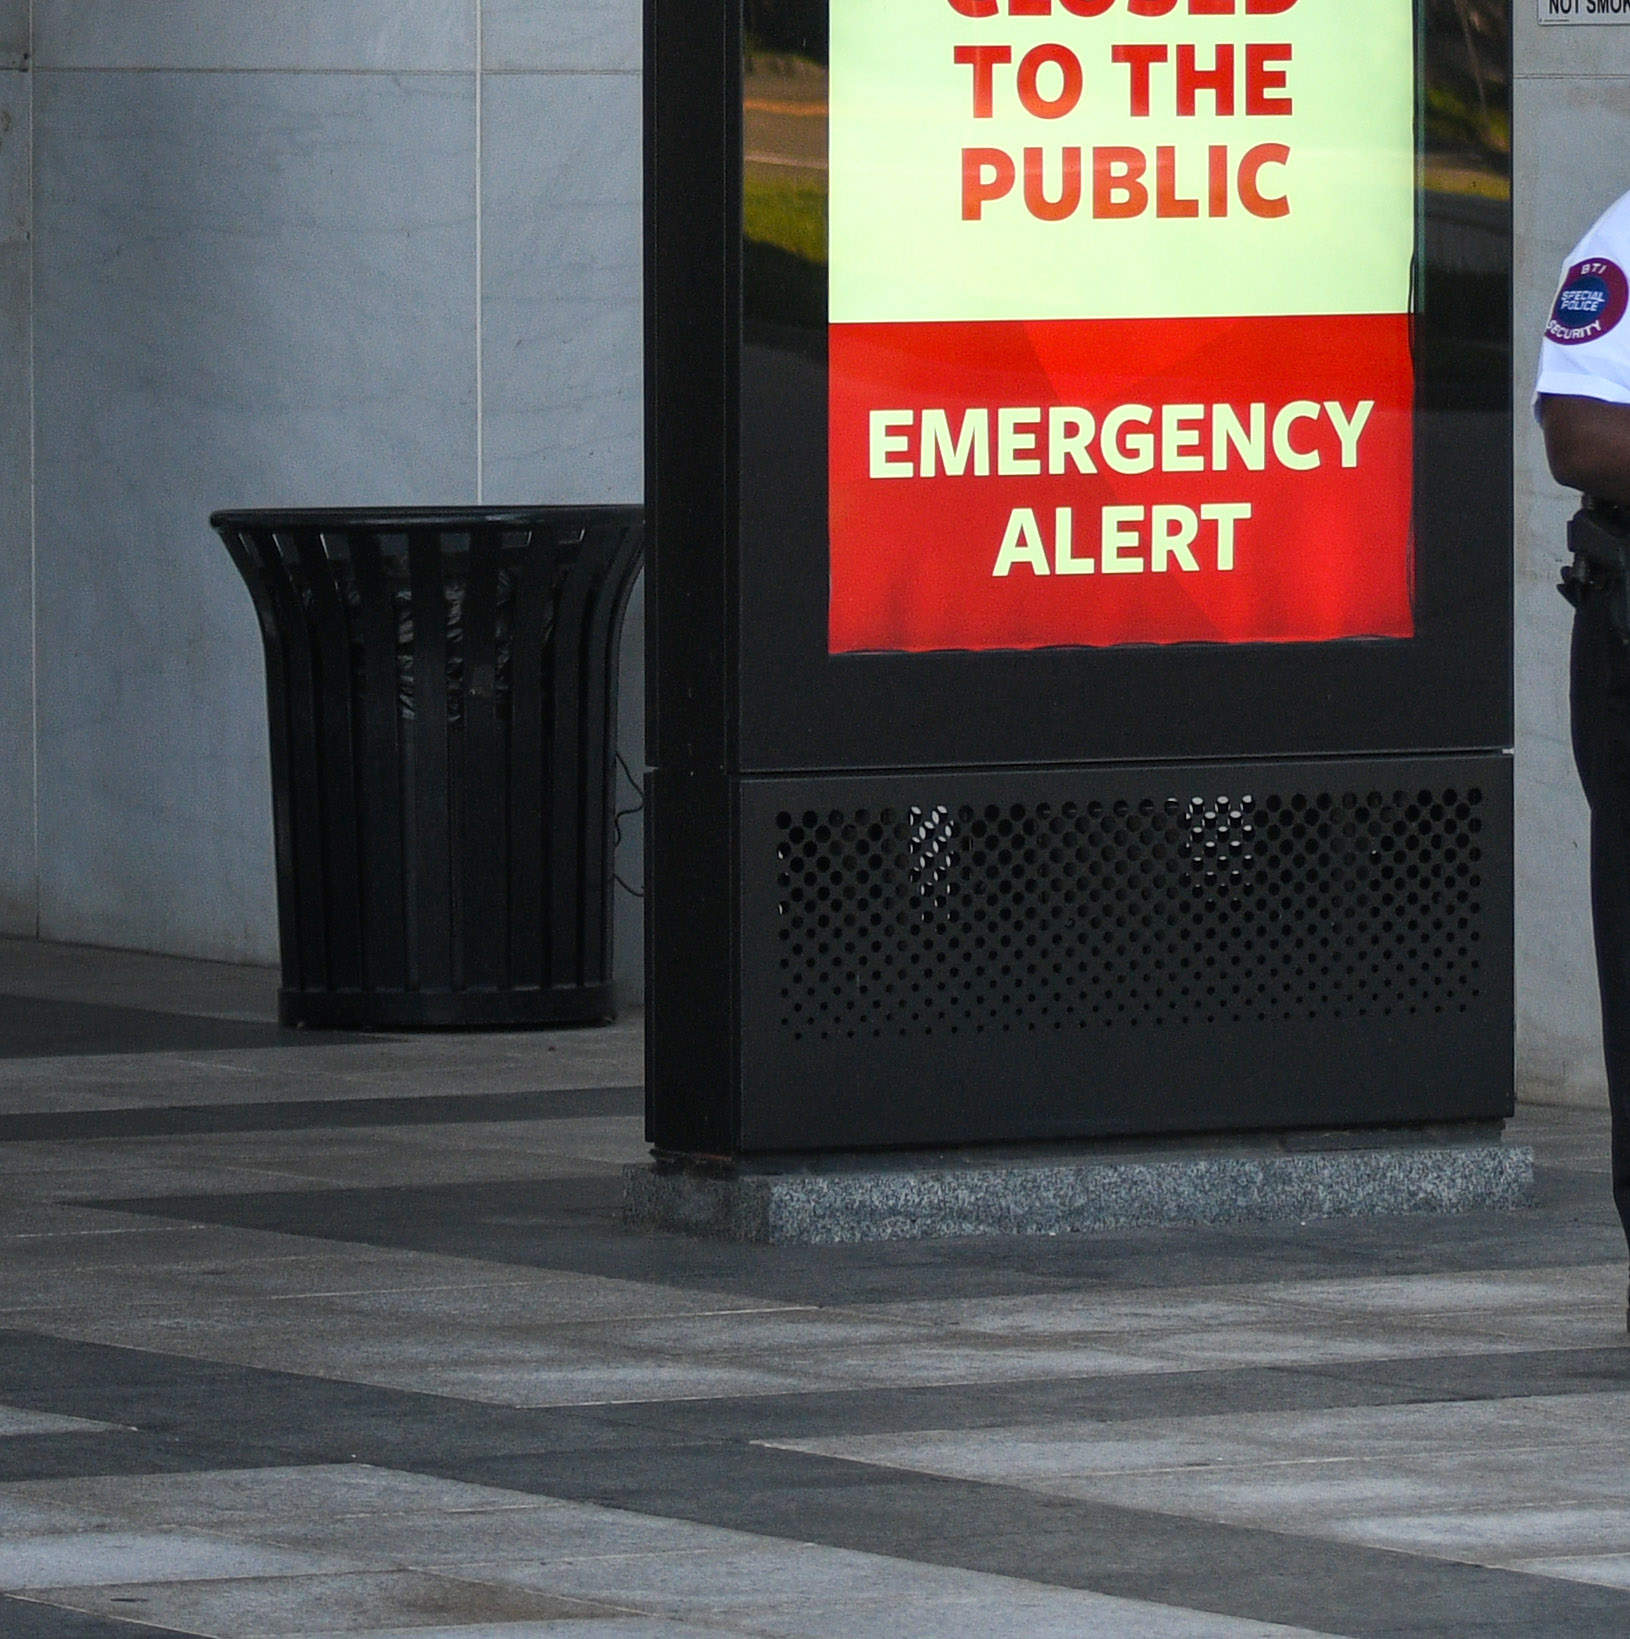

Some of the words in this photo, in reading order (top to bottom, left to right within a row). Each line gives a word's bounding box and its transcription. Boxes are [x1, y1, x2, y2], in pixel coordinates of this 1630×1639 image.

[954, 42, 1084, 120] TO
[1111, 43, 1293, 116] THE
[961, 142, 1292, 222] PUBLIC
[1580, 262, 1607, 275] BTI
[1560, 290, 1605, 302] SPECIAL
[1560, 300, 1599, 311] POLICE
[1546, 319, 1602, 339] SECURITY
[868, 399, 1376, 479] EMERGENCY
[992, 502, 1252, 577] ALERT
